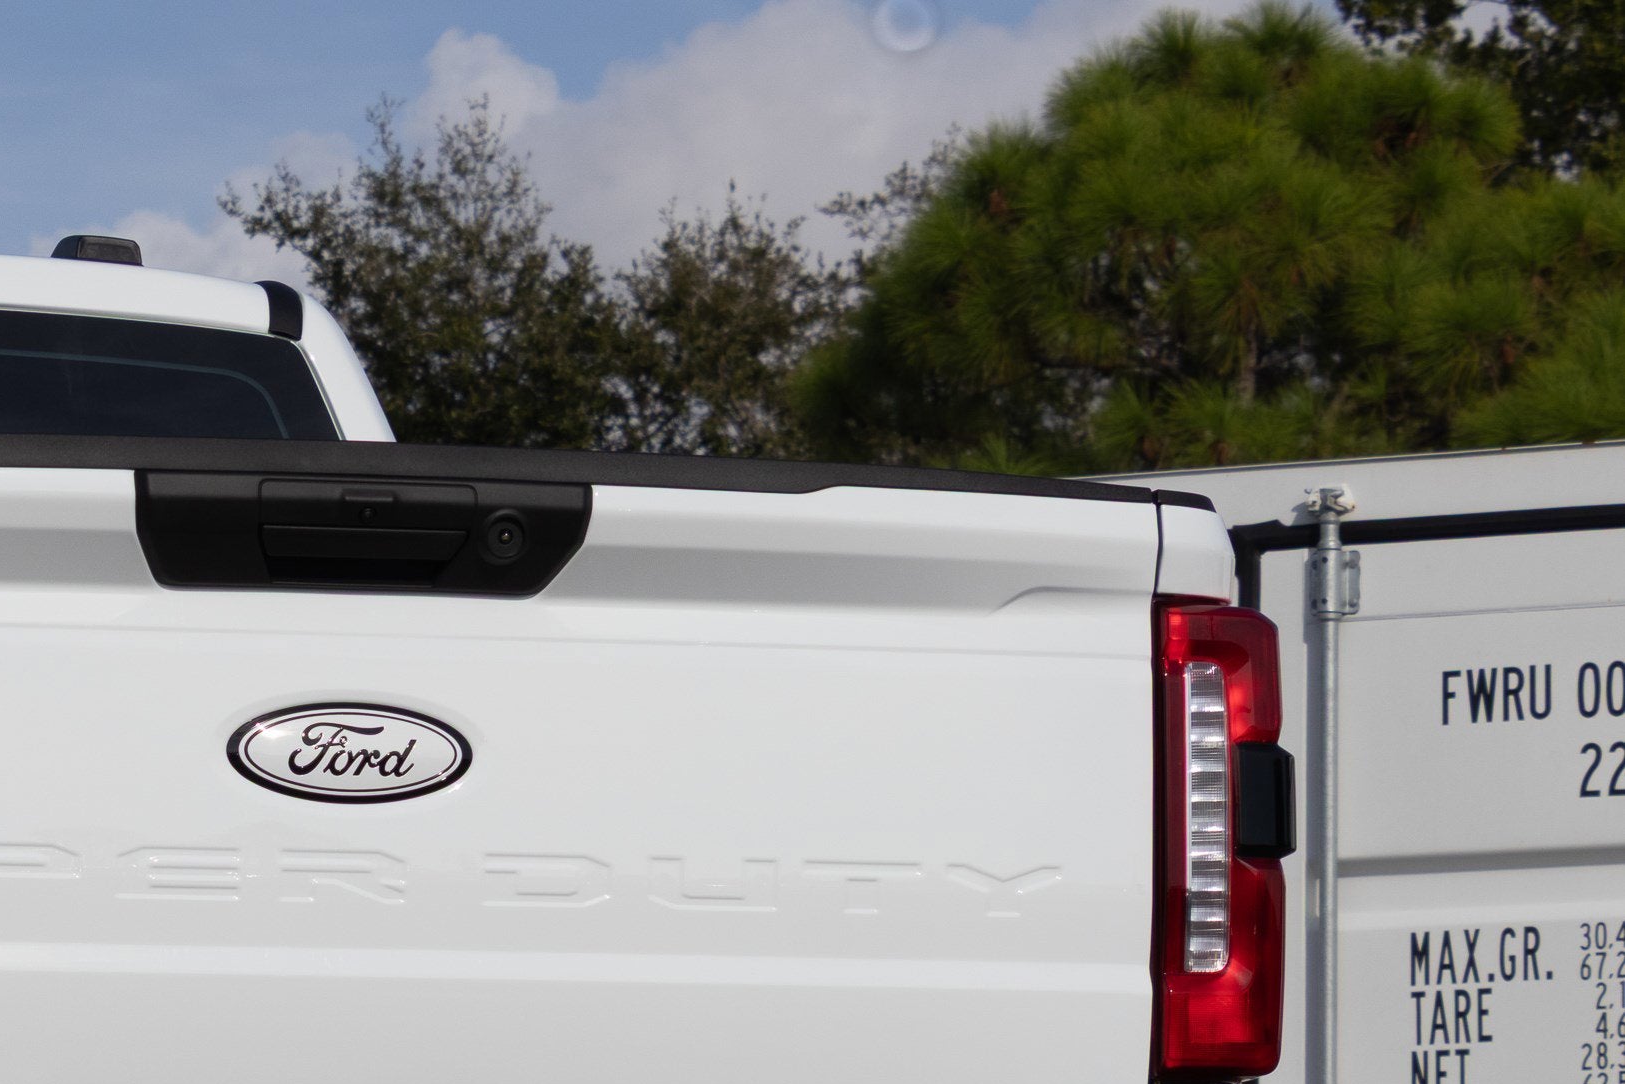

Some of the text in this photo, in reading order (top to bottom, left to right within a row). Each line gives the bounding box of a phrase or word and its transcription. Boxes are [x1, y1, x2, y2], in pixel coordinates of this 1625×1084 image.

[1442, 660, 1625, 726] FWRU 00
[288, 721, 417, 778] Ford
[1579, 741, 1625, 798] 22
[481, 852, 1062, 918] DUTY
[1410, 926, 1553, 987] MAX.GR.
[1410, 988, 1493, 1046] TARE
